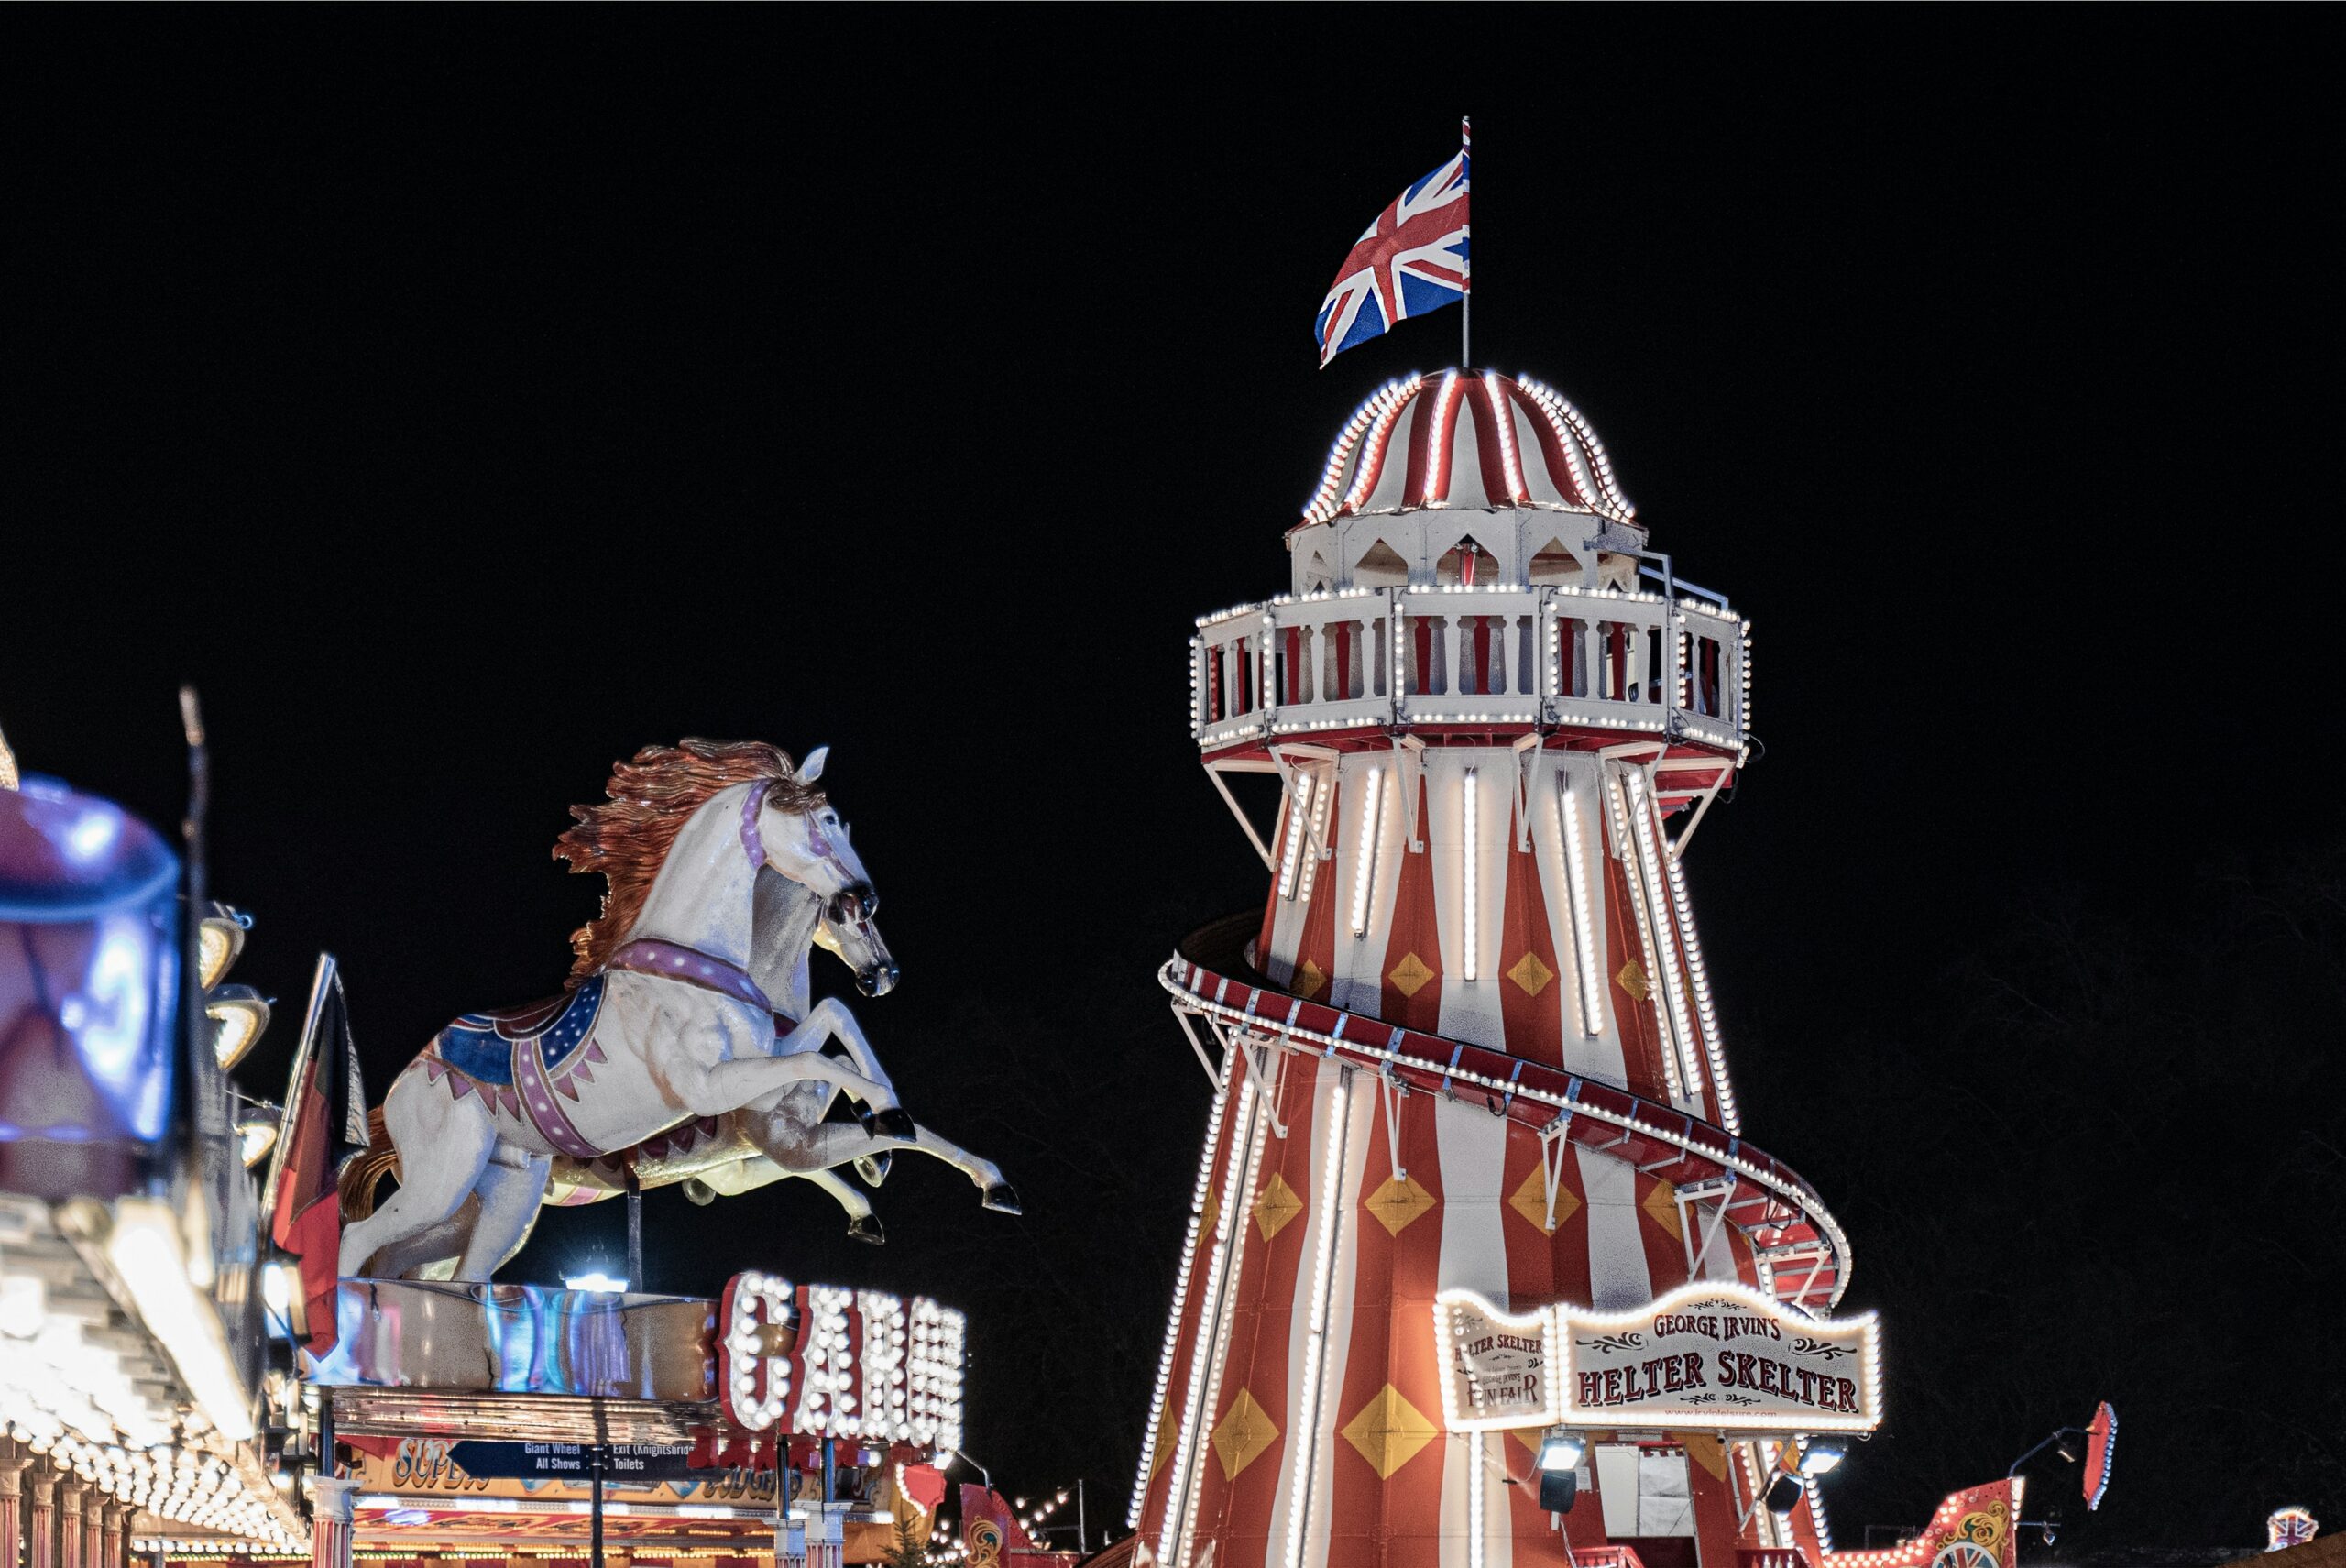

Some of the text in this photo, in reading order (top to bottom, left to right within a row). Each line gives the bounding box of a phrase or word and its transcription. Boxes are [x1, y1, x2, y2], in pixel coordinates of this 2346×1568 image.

[1653, 1314, 1781, 1342] GEORGE IRVIN'S
[1454, 1334, 1542, 1362] HLTER SKELTER
[1499, 1374, 1539, 1405] FAIR
[1577, 1350, 1859, 1413] HELTER SKELTER
[524, 1443, 580, 1455] Giant Wheel
[613, 1445, 630, 1455] Exit
[536, 1458, 581, 1470] All Shows
[614, 1458, 644, 1470] Toilets
